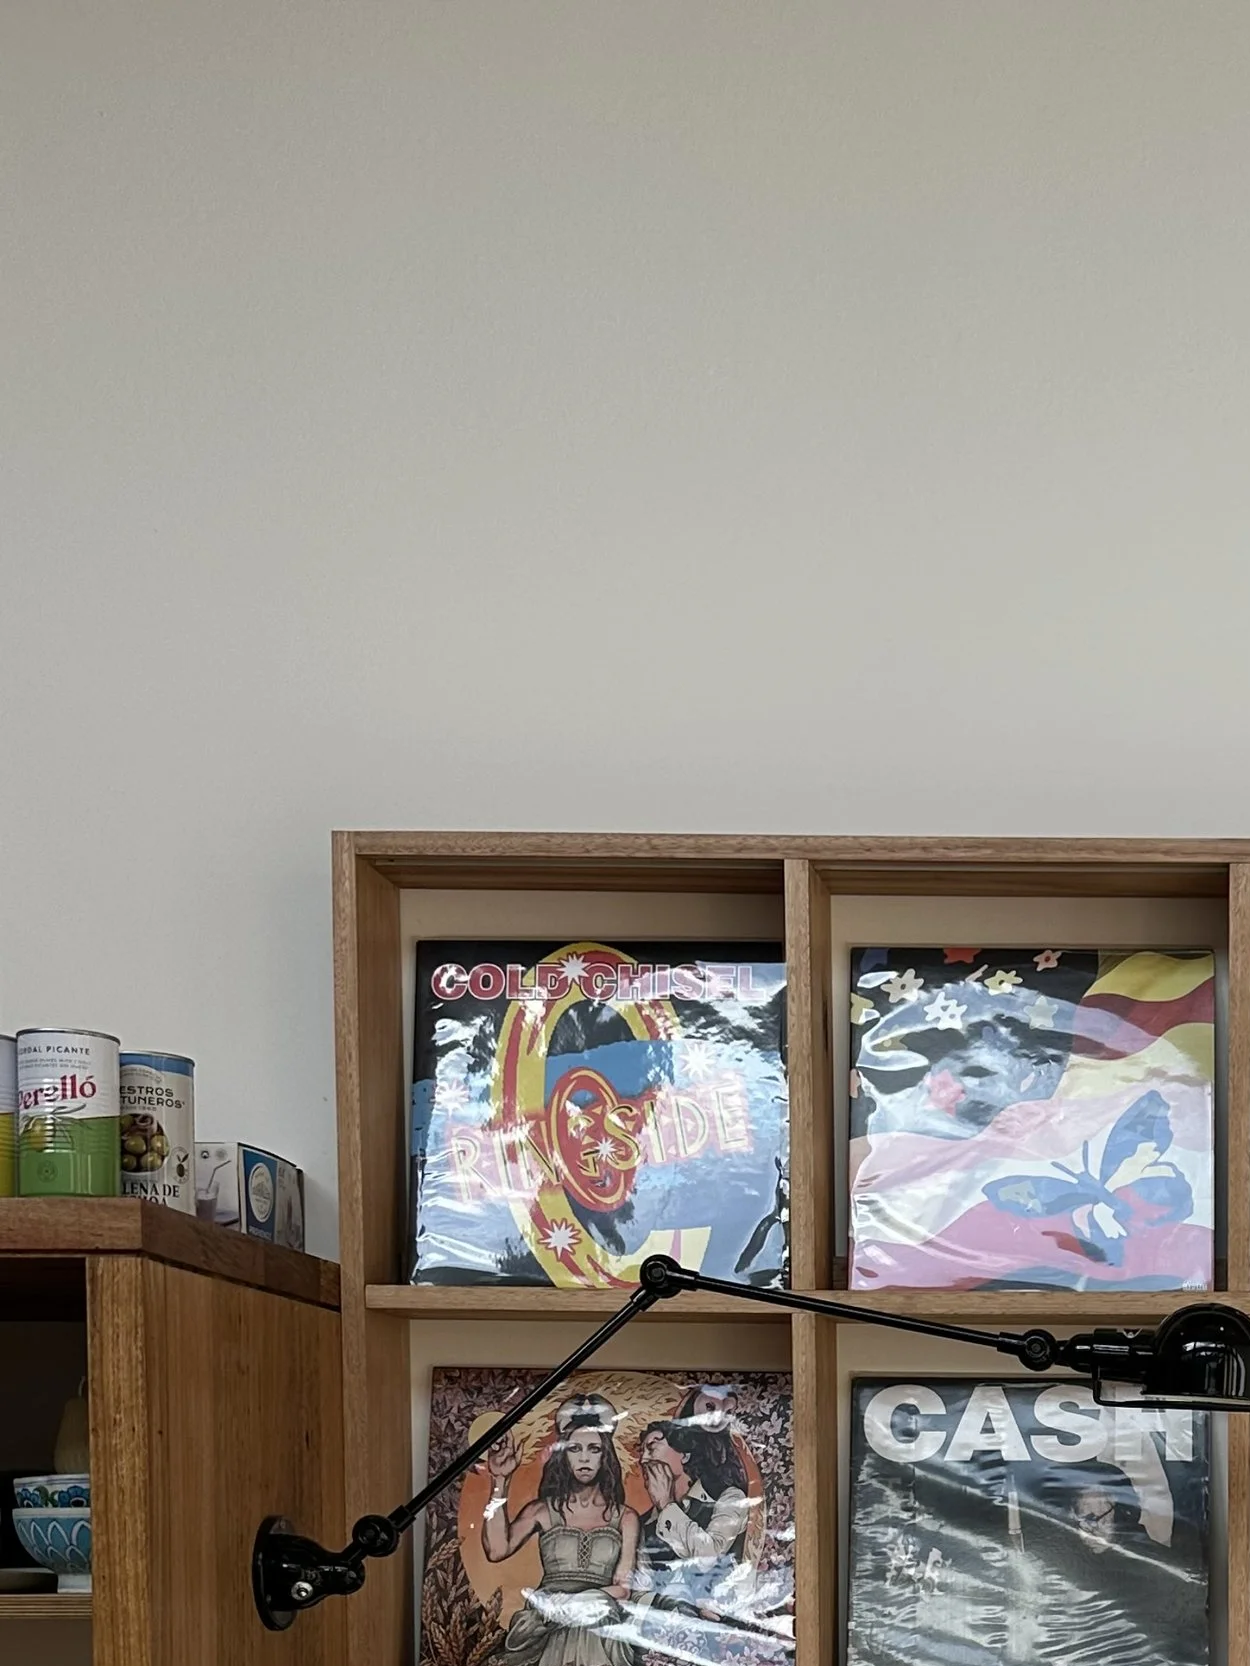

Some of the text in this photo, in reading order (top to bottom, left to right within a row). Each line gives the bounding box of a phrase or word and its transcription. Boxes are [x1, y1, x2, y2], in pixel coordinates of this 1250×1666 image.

[432, 963, 767, 1001] COLD CHISEL
[46, 1045, 91, 1056] PICANTE
[162, 1185, 180, 1198] DE
[863, 1384, 1193, 1463] CASH
